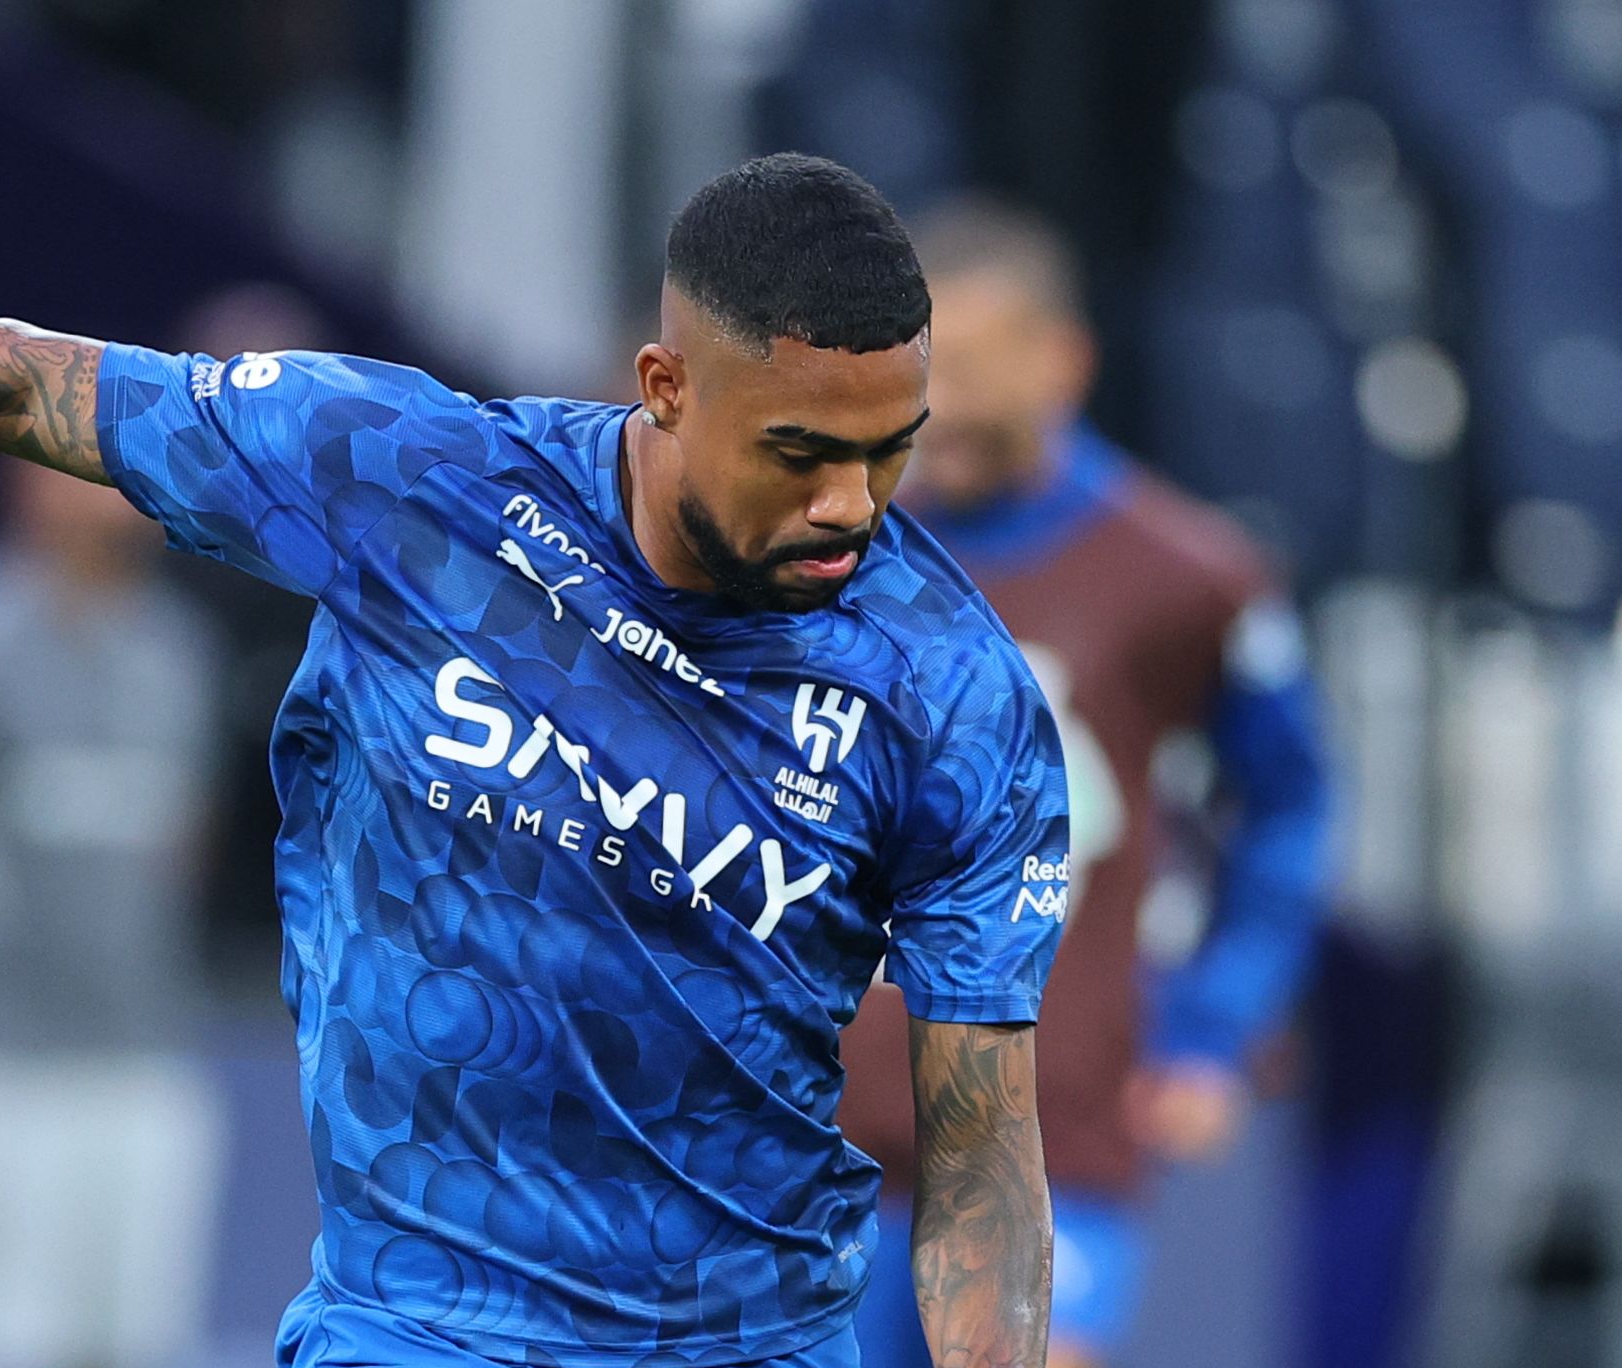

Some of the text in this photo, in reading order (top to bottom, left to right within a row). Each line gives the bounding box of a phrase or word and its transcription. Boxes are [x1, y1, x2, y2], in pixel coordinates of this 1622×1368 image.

[502, 494, 607, 575] flyn
[427, 780, 626, 867] GAMES
[774, 767, 839, 805] ALHILAL
